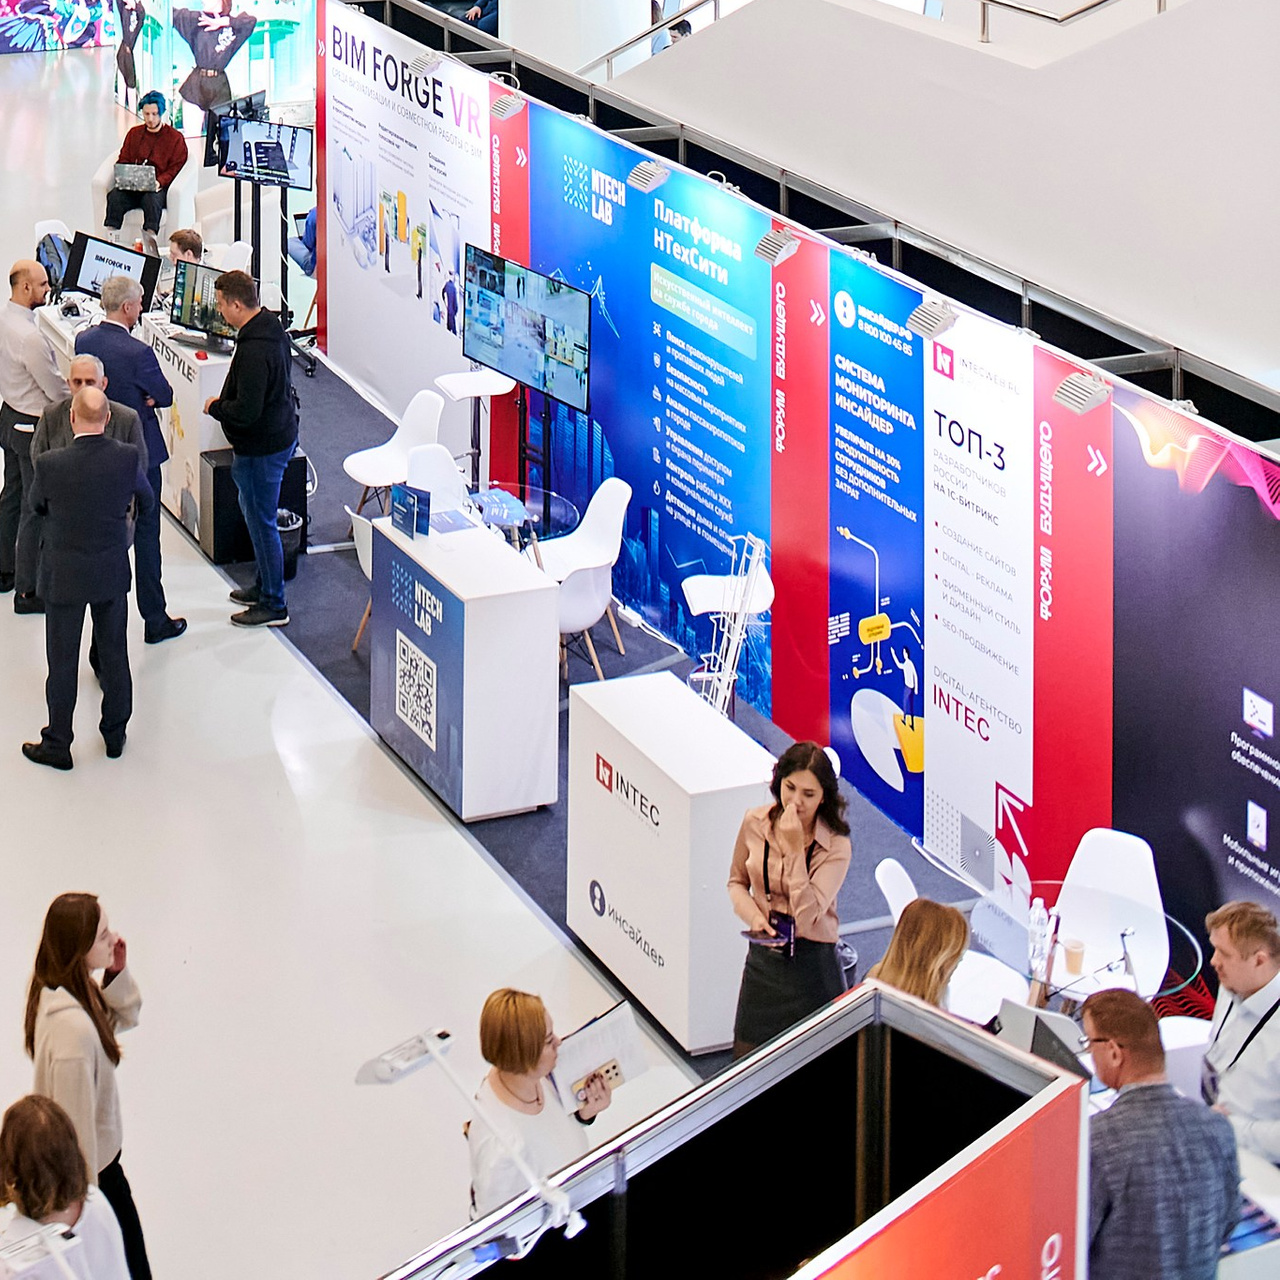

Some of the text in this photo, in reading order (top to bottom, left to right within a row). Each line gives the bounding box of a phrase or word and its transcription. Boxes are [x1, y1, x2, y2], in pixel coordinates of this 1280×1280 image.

[332, 25, 482, 139] BIM FORGE VR
[396, 102, 438, 135] СОВМЕСТНОЙ
[438, 126, 464, 147] РАБОТЫ
[591, 167, 626, 208] NTECH
[591, 194, 613, 226] LAB
[654, 197, 742, 262] Платформа
[94, 254, 105, 264] BIM
[124, 263, 132, 272] VR
[654, 227, 728, 286] НТехСити
[653, 270, 754, 336] Искусственный интеллект
[152, 333, 193, 383] JETSTYLE
[666, 330, 686, 350] Поиск
[858, 319, 864, 331] 8
[864, 322, 879, 339] 800
[879, 330, 892, 346] 100
[892, 338, 902, 351] 45
[666, 362, 709, 396] Безопасность
[776, 282, 786, 454] ФОРУМ БУДУЩЕГО
[834, 354, 886, 394] СИСТЕМА
[666, 394, 689, 417] Анализ
[835, 372, 917, 430] МОНИТОРИНГА
[835, 392, 894, 435] ИНСАЙДЕР
[665, 425, 704, 458] Управление
[835, 423, 902, 471] УВЕЛИЧЬТЕ НА 30%
[835, 437, 900, 484] ПРОДУКТИВНОСТЬ
[934, 408, 1006, 471] ТОП-3
[665, 457, 696, 486] Контроль
[718, 493, 732, 511] ЖКХ
[835, 451, 886, 490] СОТРУДНИКОВ
[835, 478, 860, 501] ЗАТРАТ
[835, 464, 918, 523] БЕЗ ДОПОЛНИТЕЛЬНЫХ
[933, 448, 1007, 498] РАЗРАБОТЧИКОВ
[933, 464, 968, 491] РОССИИ
[665, 489, 696, 518] Детекция
[933, 480, 1000, 527] НА 1С-БИТРИКС
[1040, 420, 1054, 620] ФОРУМ БУДУЩЕГО
[942, 525, 1017, 577] СОЗДАНИЕ САЙТОВ
[942, 551, 971, 576] DIGITAL
[976, 574, 1014, 602] РЕКЛАМА
[414, 580, 443, 624] NTECH
[414, 603, 432, 636] LAB
[942, 578, 1022, 635] ФИРМЕННЫЙ СТИЛЬ
[949, 596, 982, 623] ДИЗАЙН
[942, 617, 1020, 677] SEO-ПРОДВИЖЕНИЕ
[933, 684, 990, 742] INTEC
[934, 665, 1022, 736] DIGITAL-АГЕНТСТВО
[616, 771, 660, 827] INTEC
[608, 904, 665, 968] инсайдер
